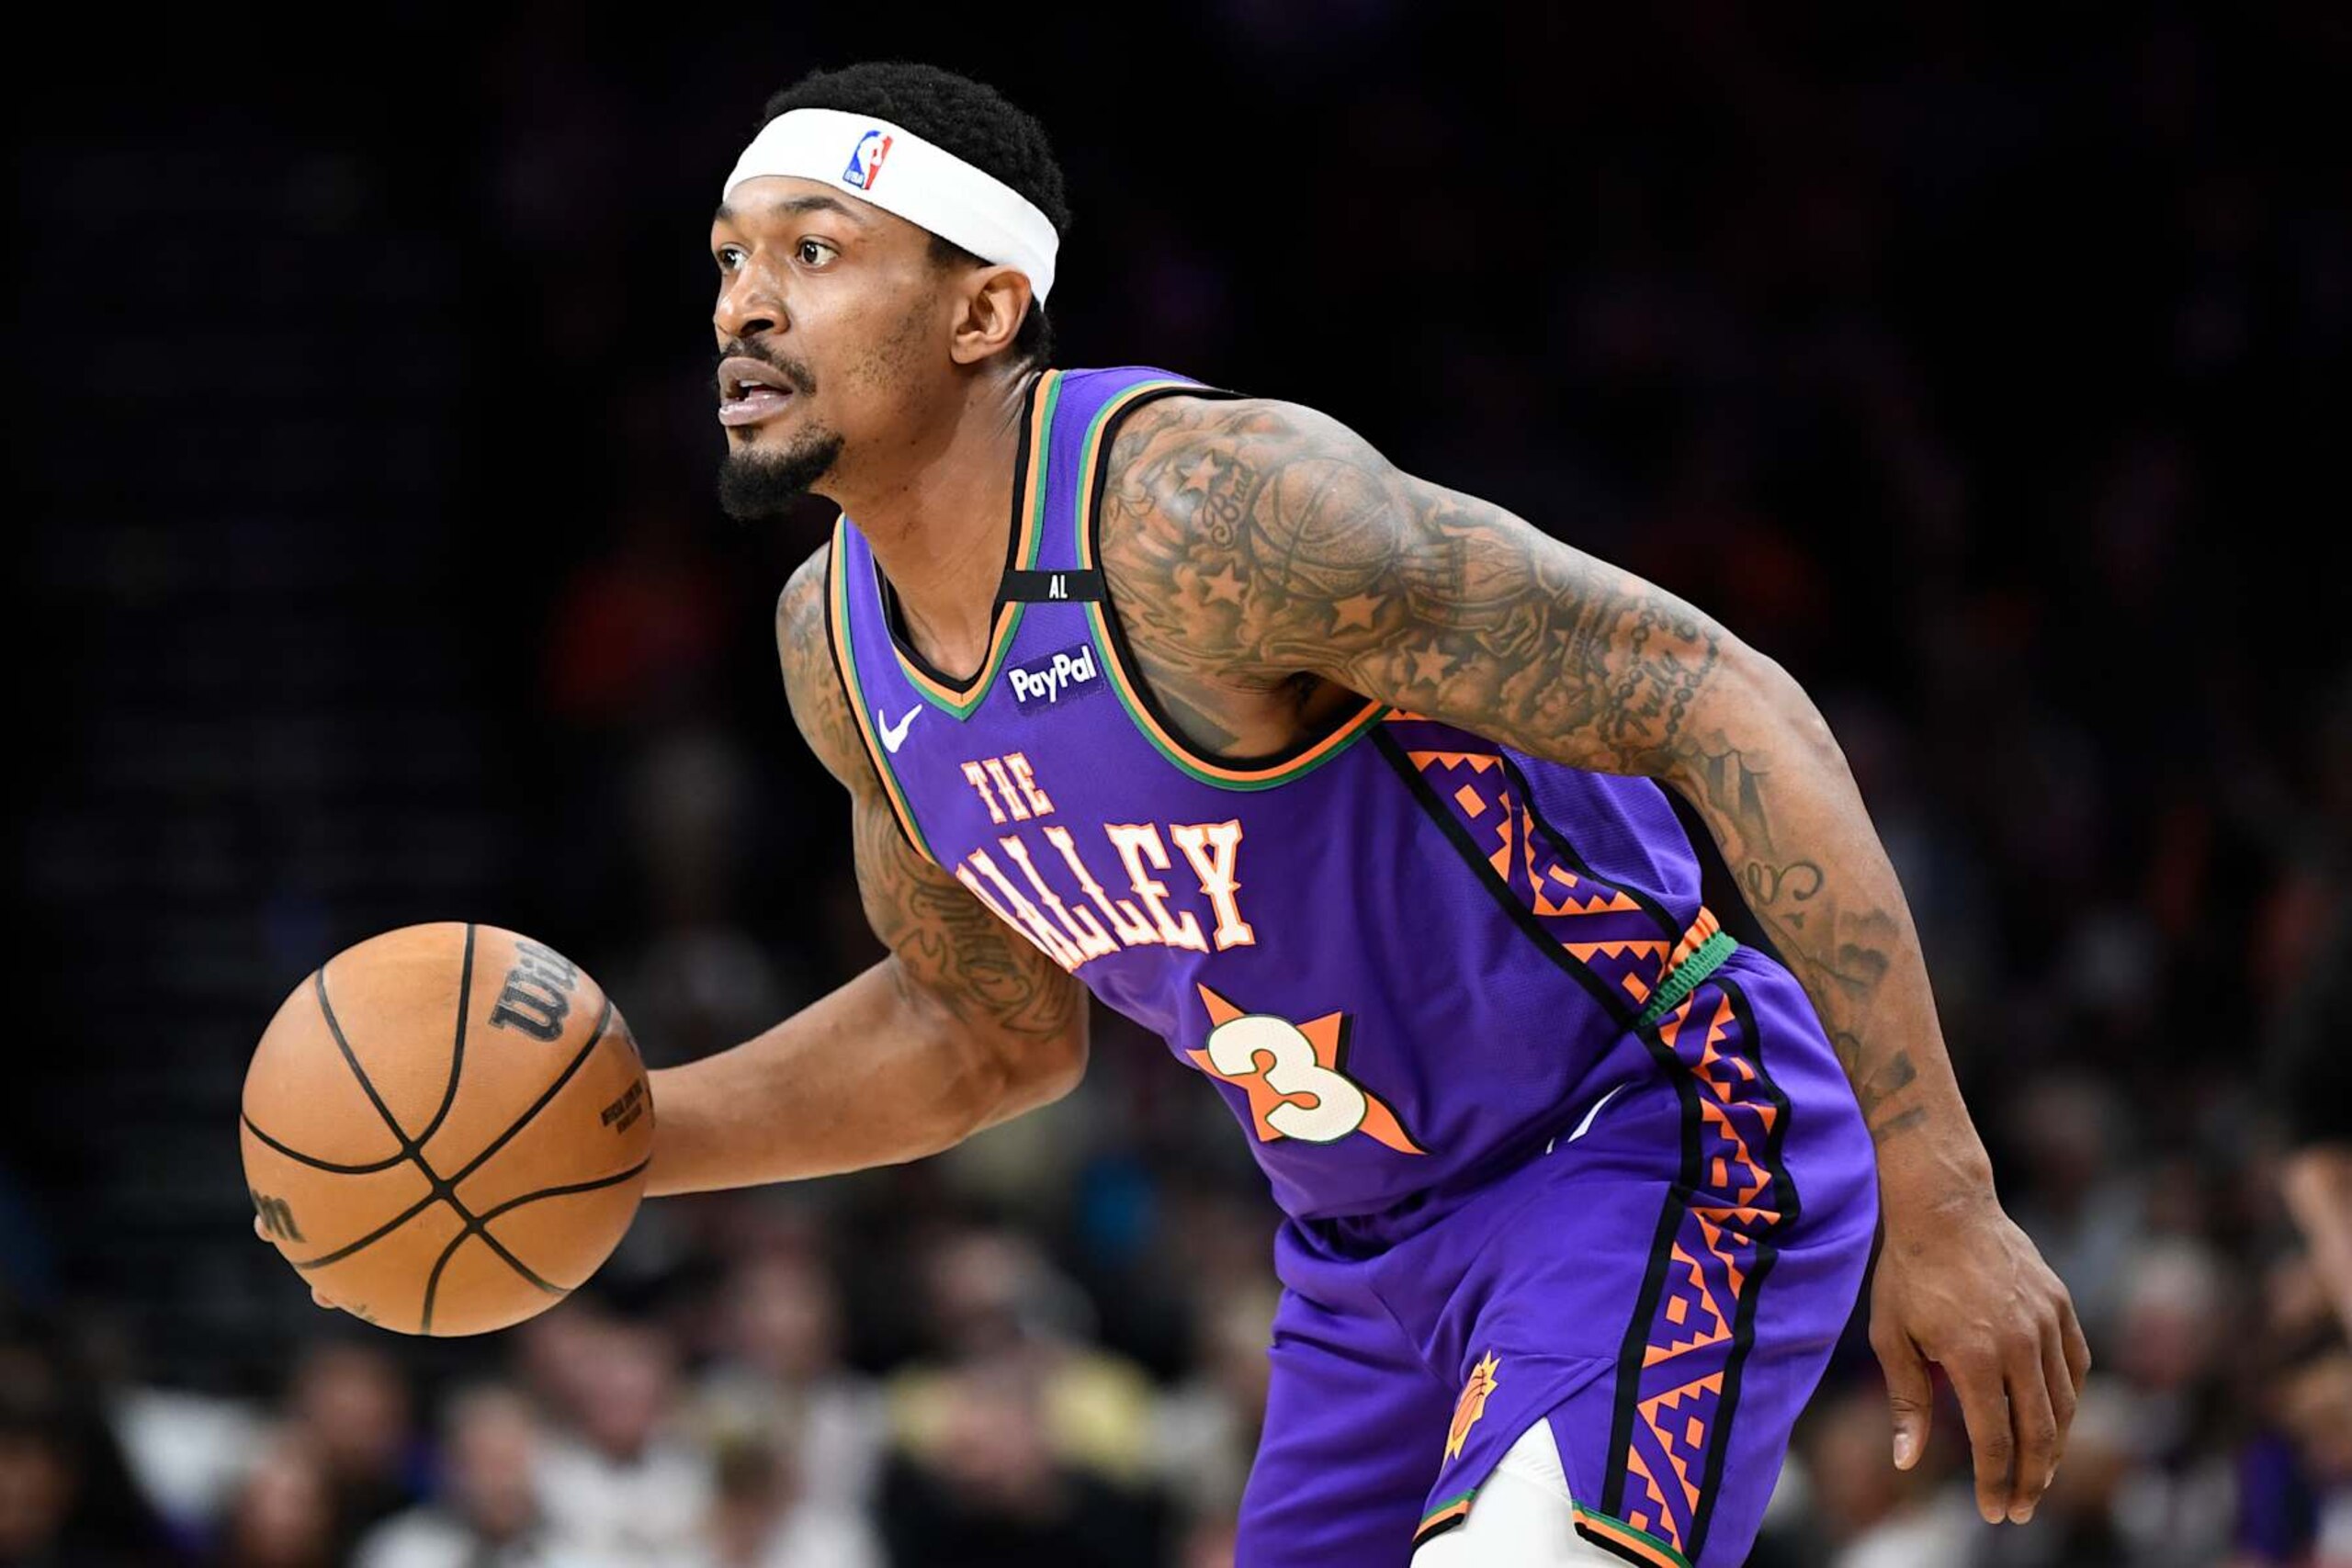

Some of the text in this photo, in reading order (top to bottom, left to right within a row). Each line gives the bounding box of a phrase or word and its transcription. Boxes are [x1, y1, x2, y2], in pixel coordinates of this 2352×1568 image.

[1048, 574, 1069, 599] AL
[1008, 645, 1097, 704] PayPal
[961, 751, 1056, 825] THE
[1206, 1013, 1368, 1145] 3
